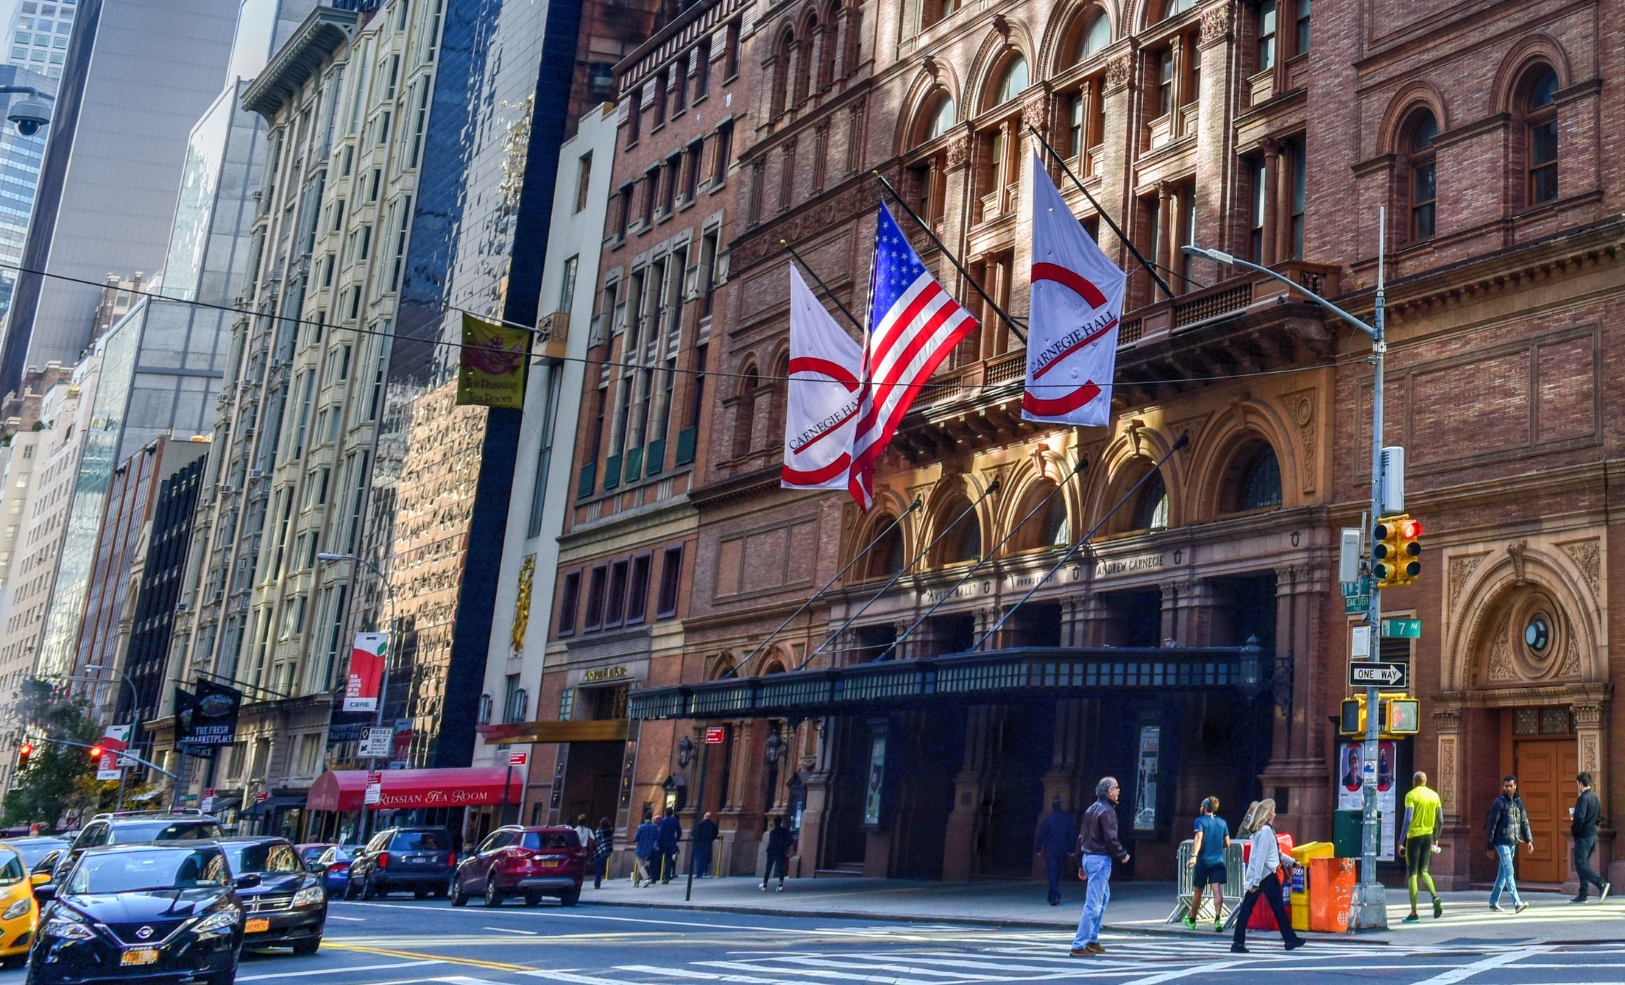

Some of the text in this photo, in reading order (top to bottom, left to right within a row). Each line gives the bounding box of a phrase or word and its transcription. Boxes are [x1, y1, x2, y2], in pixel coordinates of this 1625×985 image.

[1031, 310, 1116, 373] CARNEGIE HALL
[481, 379, 518, 392] Russian
[485, 394, 512, 403] Room
[789, 397, 859, 449] CARNEGIE HA
[1097, 556, 1164, 575] ANDREW CARNEGIE
[1398, 622, 1406, 635] 7
[1358, 669, 1398, 679] ONE WAY
[209, 726, 229, 734] FRESH
